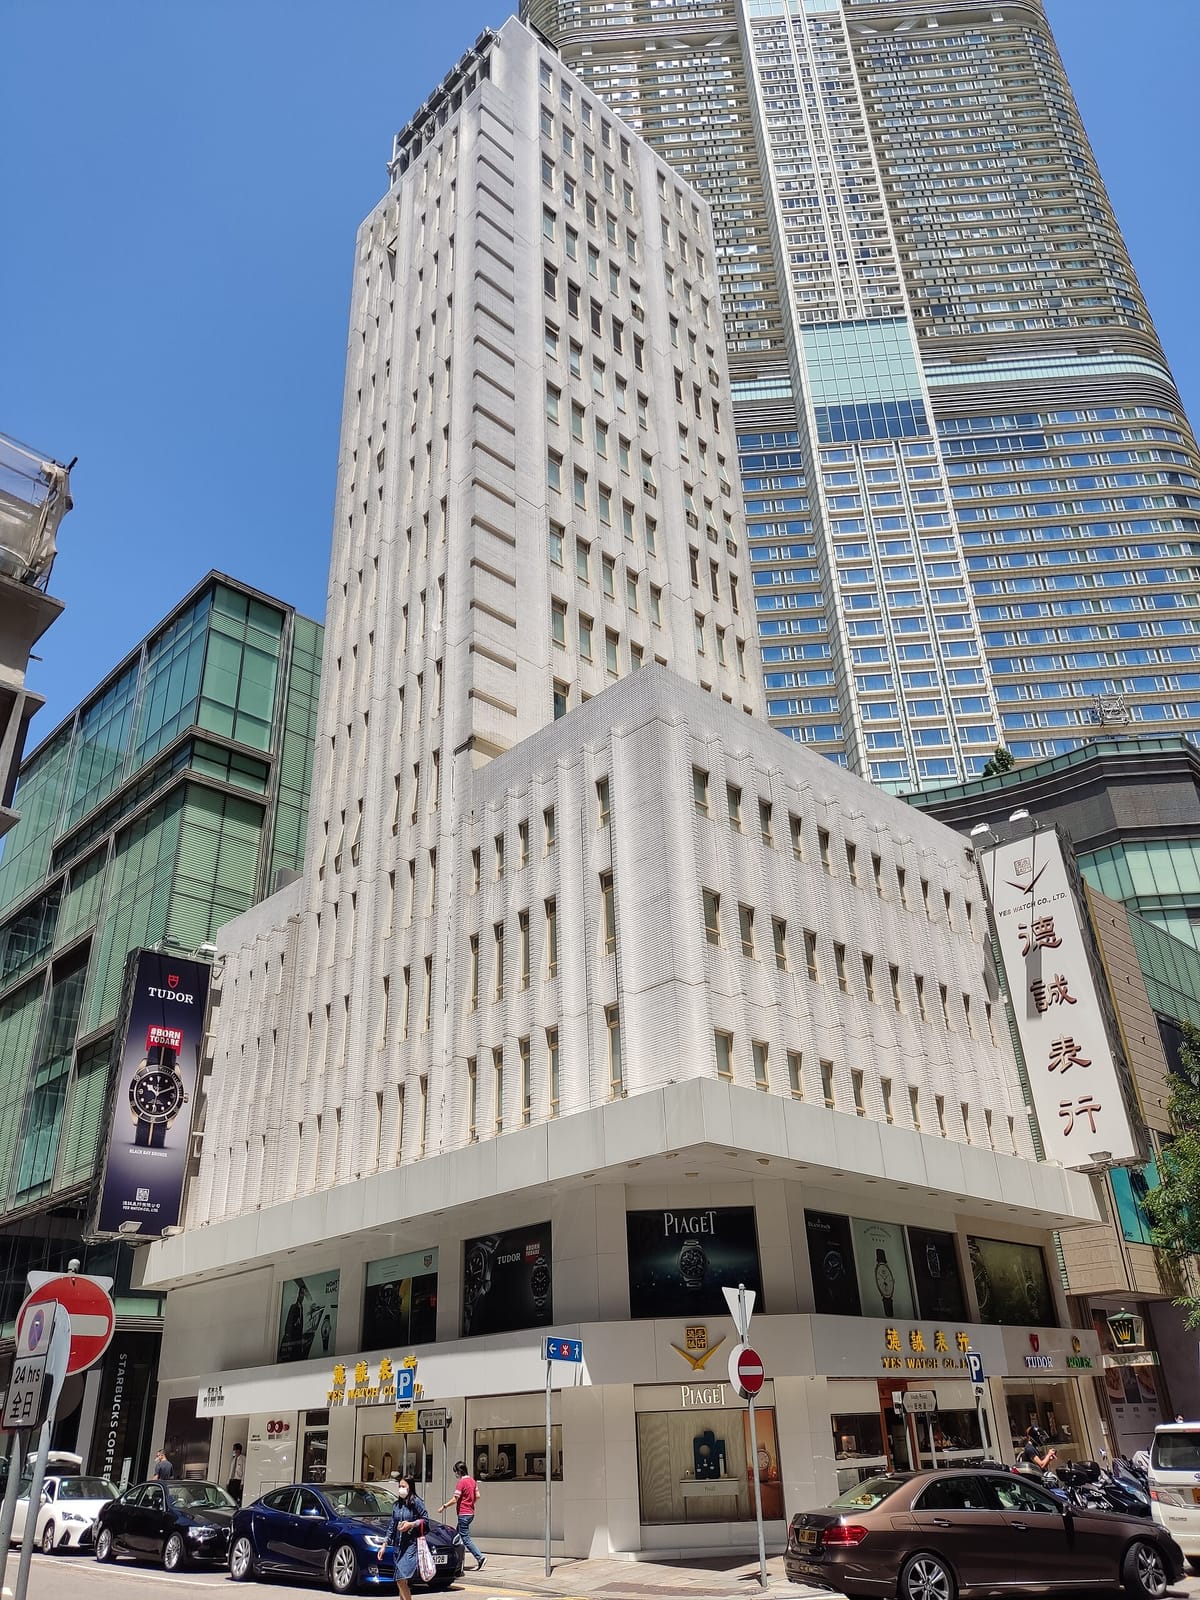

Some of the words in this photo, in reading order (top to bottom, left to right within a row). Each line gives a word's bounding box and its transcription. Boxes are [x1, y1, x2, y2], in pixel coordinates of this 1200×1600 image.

[998, 909, 1012, 917] YES
[1013, 901, 1036, 913] WATCH
[148, 986, 194, 1004] TUDOR
[150, 1027, 181, 1040] #BORN
[1018, 915, 1101, 1137] 德誠表行
[663, 1211, 717, 1236] PIAGET
[497, 1252, 521, 1265] TUDOR
[882, 1357, 902, 1368] YES
[906, 1357, 938, 1369] WATCH
[969, 1355, 980, 1380] P
[1025, 1356, 1054, 1368] TUDOR
[1066, 1356, 1094, 1368] ROLEX
[1113, 1352, 1150, 1366] ROLEX
[14, 1366, 26, 1384] 24
[27, 1365, 40, 1384] hrs
[110, 1353, 127, 1428] STARBUCKS
[327, 1390, 344, 1400] YES
[348, 1386, 379, 1399] WATCH
[399, 1373, 410, 1395] P
[10, 1391, 34, 1418] 全日
[681, 1384, 727, 1407] PIAGET
